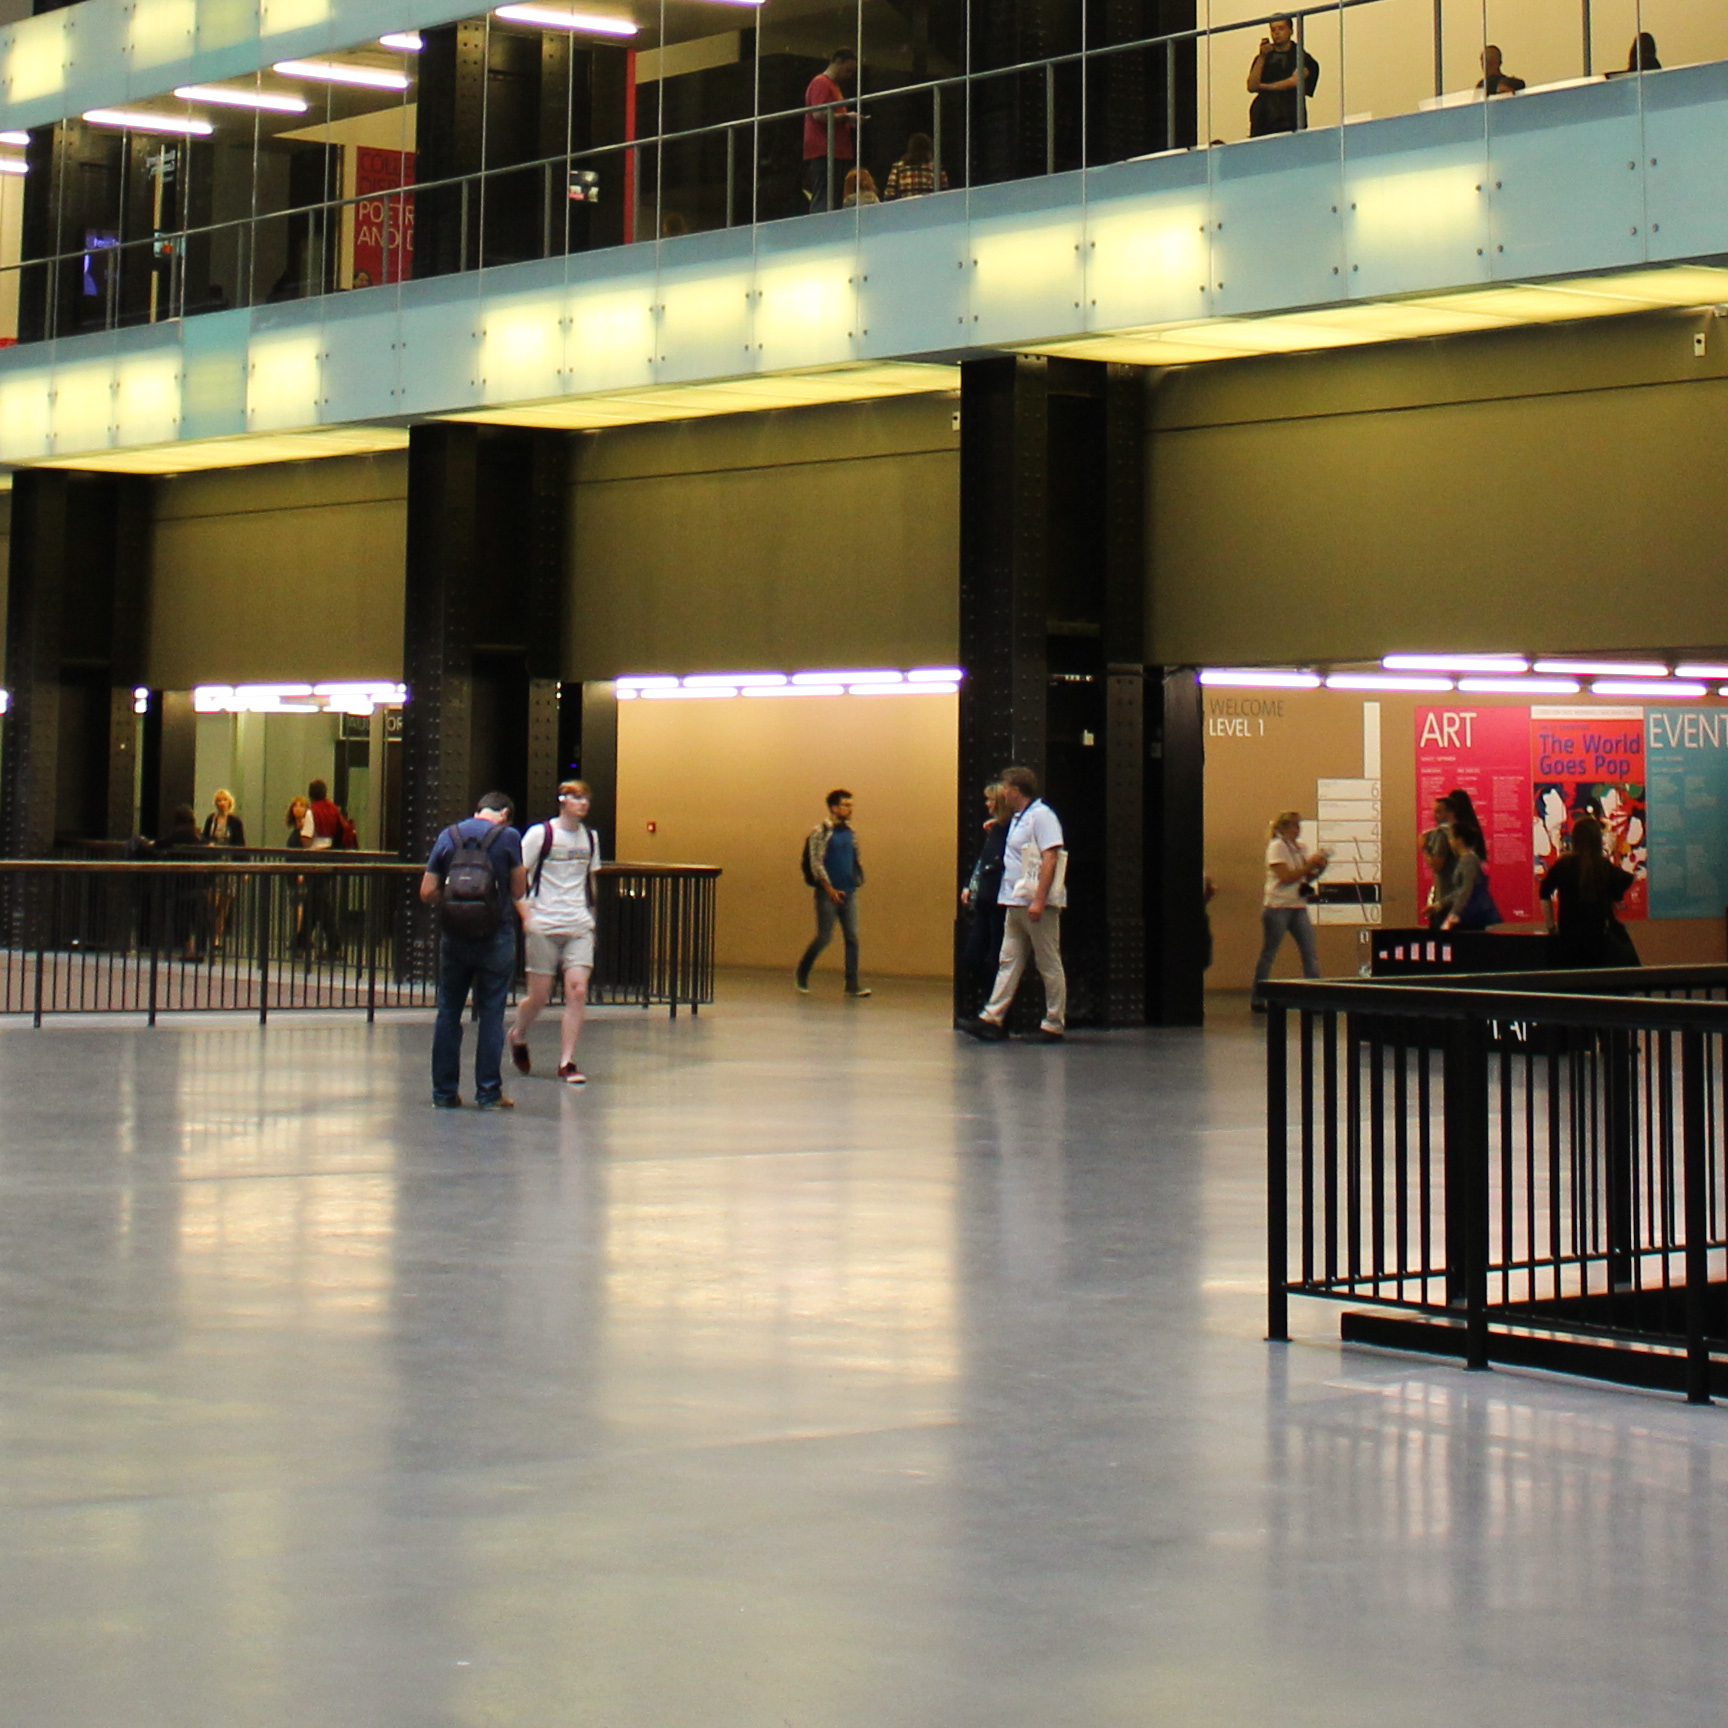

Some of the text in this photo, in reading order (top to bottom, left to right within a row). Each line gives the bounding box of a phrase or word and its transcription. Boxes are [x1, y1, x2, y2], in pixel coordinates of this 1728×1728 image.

[1210, 698, 1285, 717] WELCOME
[1209, 718, 1265, 737] LEVEL 1
[1420, 712, 1477, 748] ART
[1540, 733, 1641, 755] The World
[1539, 755, 1631, 779] Goes Pop
